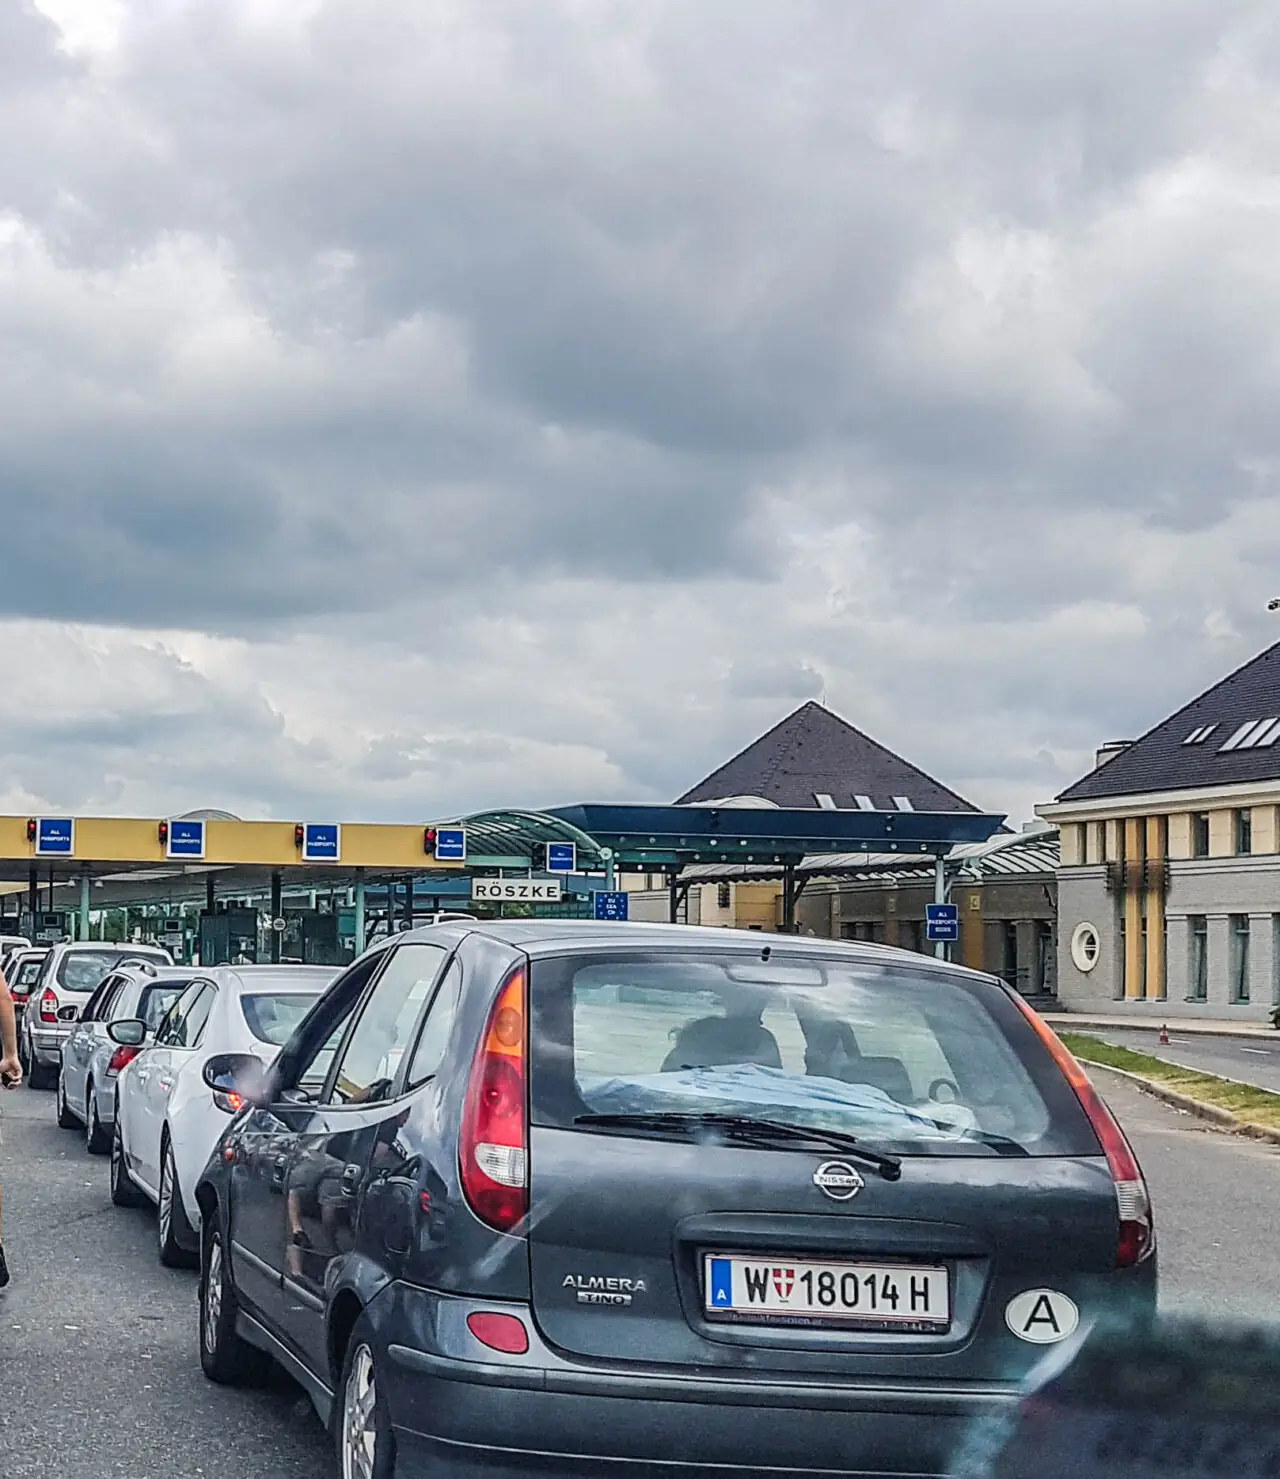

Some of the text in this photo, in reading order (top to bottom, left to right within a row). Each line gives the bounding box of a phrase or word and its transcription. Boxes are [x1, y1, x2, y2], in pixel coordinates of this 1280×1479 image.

[475, 881, 558, 898] RÖSZKE
[819, 1176, 860, 1185] NISSAN
[562, 1273, 647, 1292] ALMERA
[743, 1266, 930, 1312] W 18014 H
[585, 1293, 625, 1305] TINO
[716, 1288, 727, 1301] A
[1023, 1294, 1061, 1333] A
